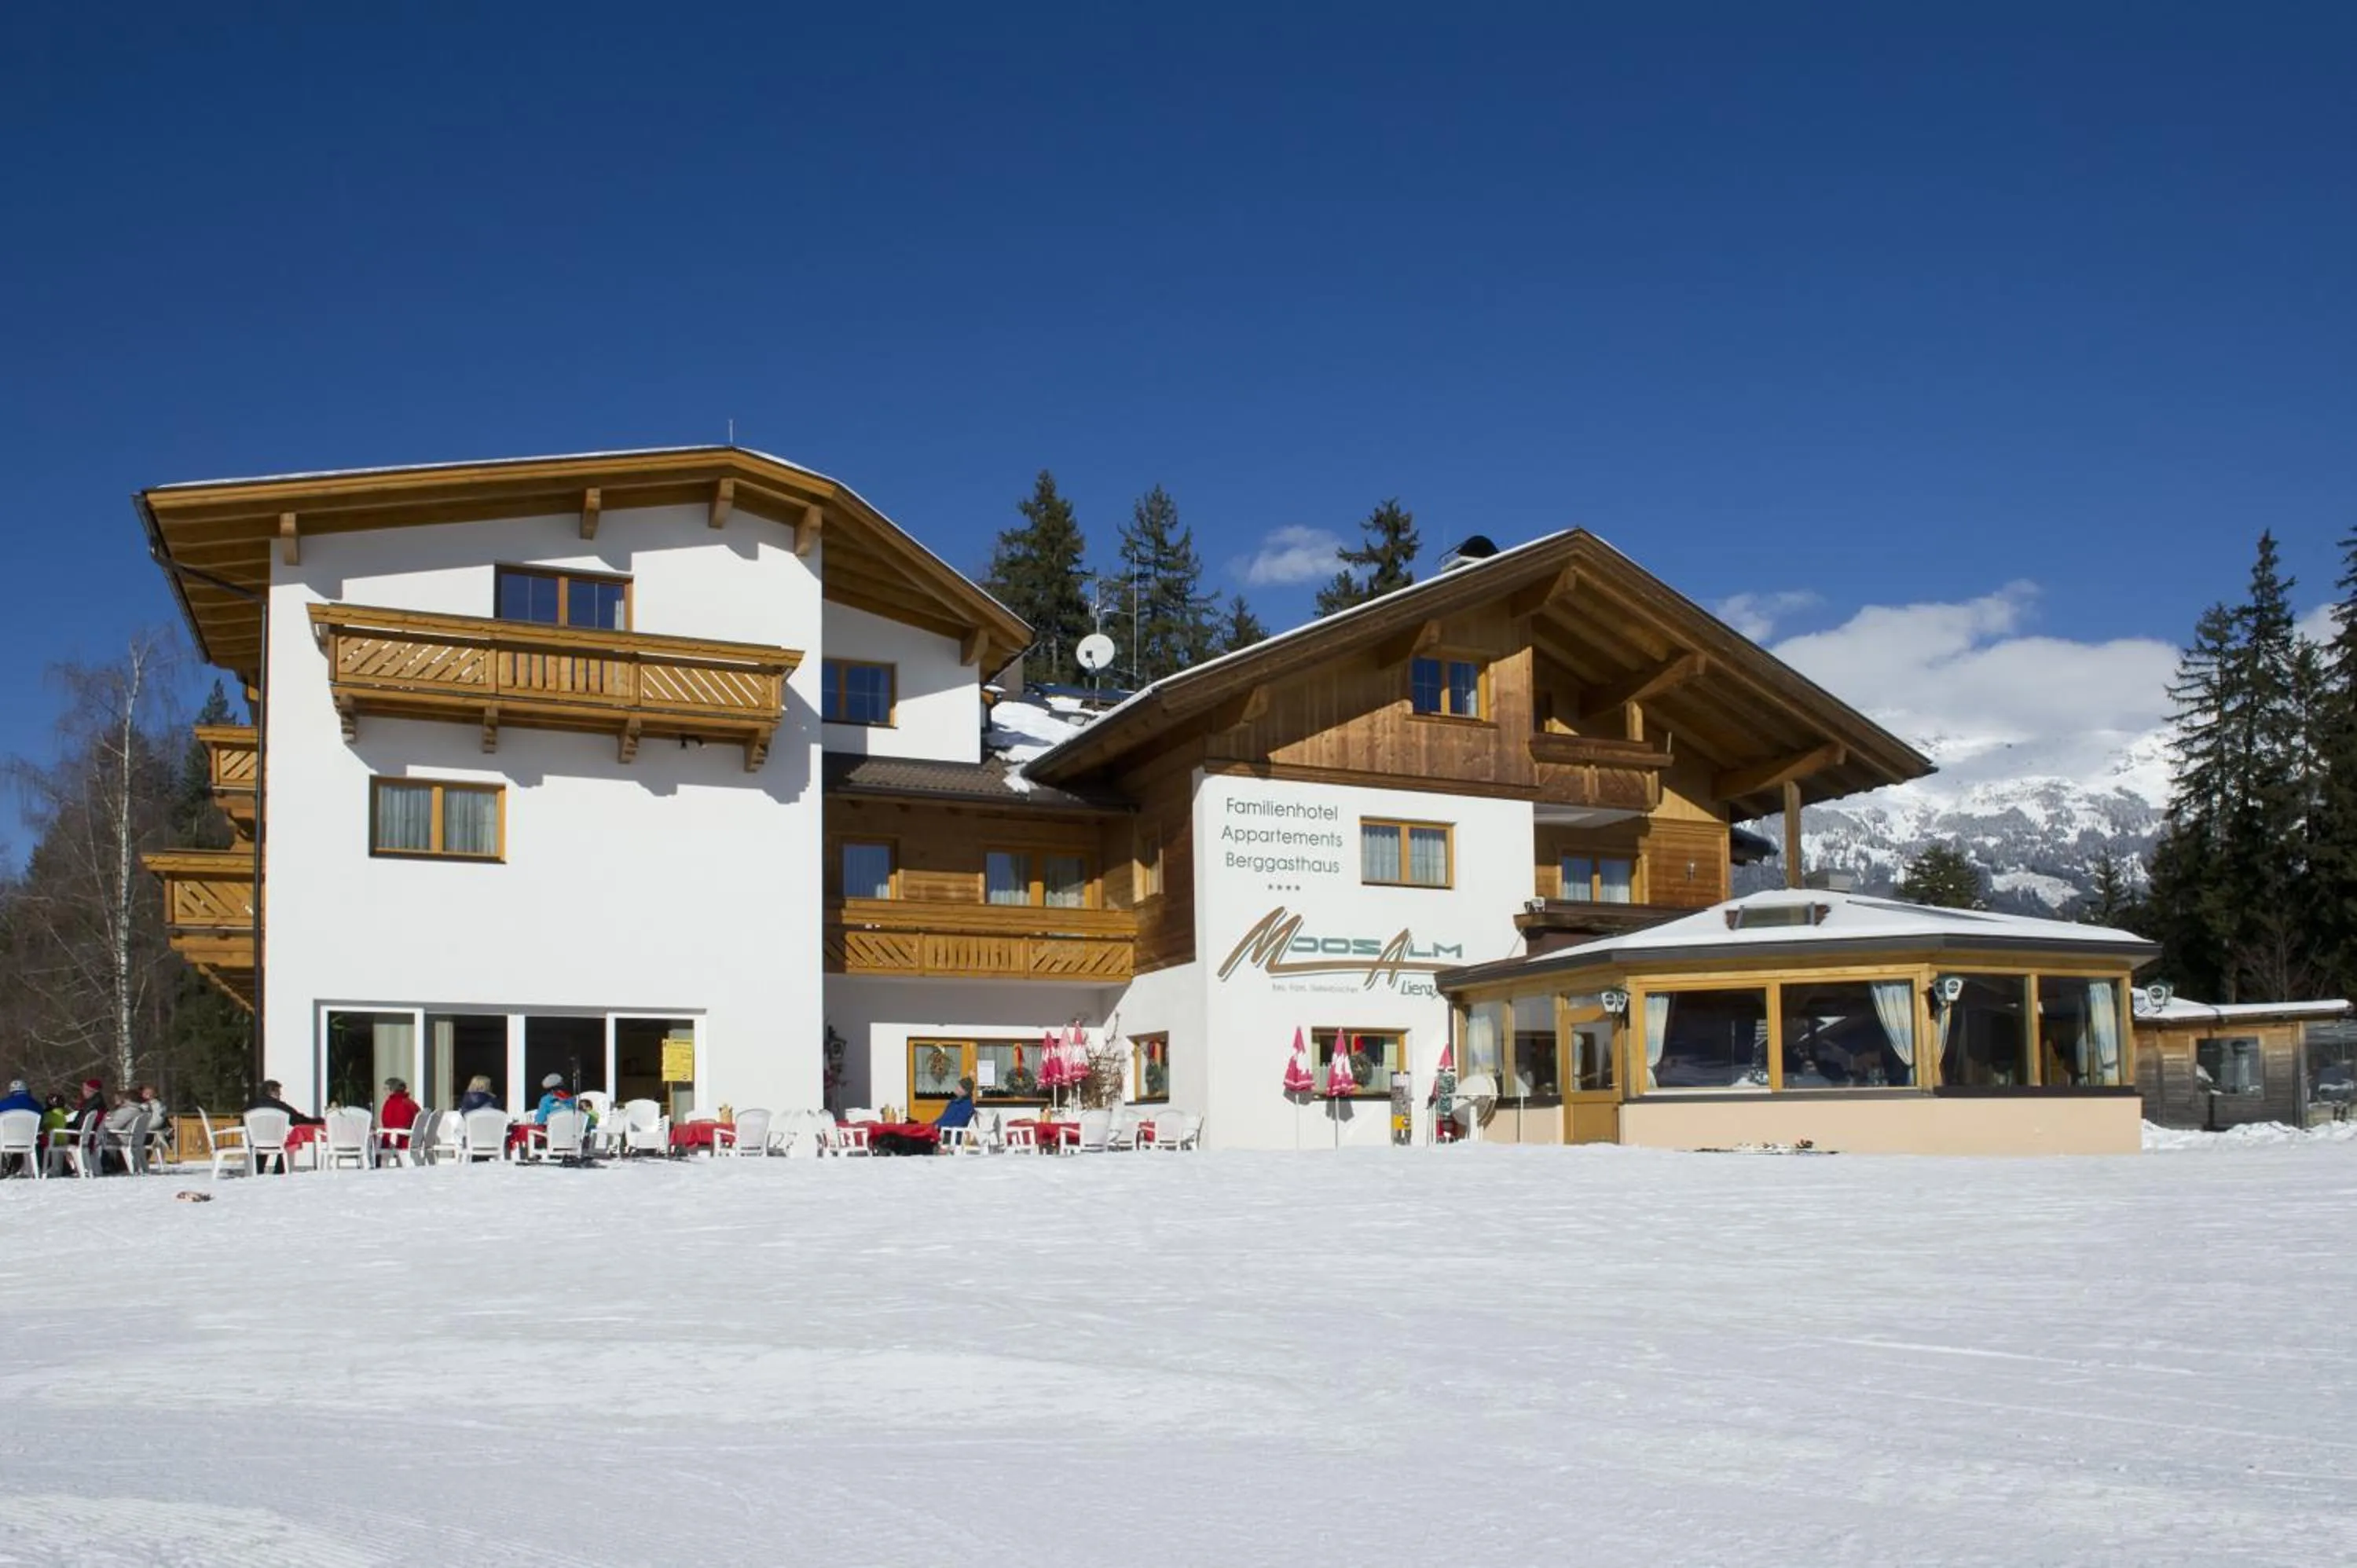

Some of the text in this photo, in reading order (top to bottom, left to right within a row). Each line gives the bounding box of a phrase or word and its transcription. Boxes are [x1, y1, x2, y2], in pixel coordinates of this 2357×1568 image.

[1226, 797, 1338, 821] Familienhotel
[1221, 825, 1343, 847] Appartements
[1226, 852, 1340, 873] Berggasthaus
